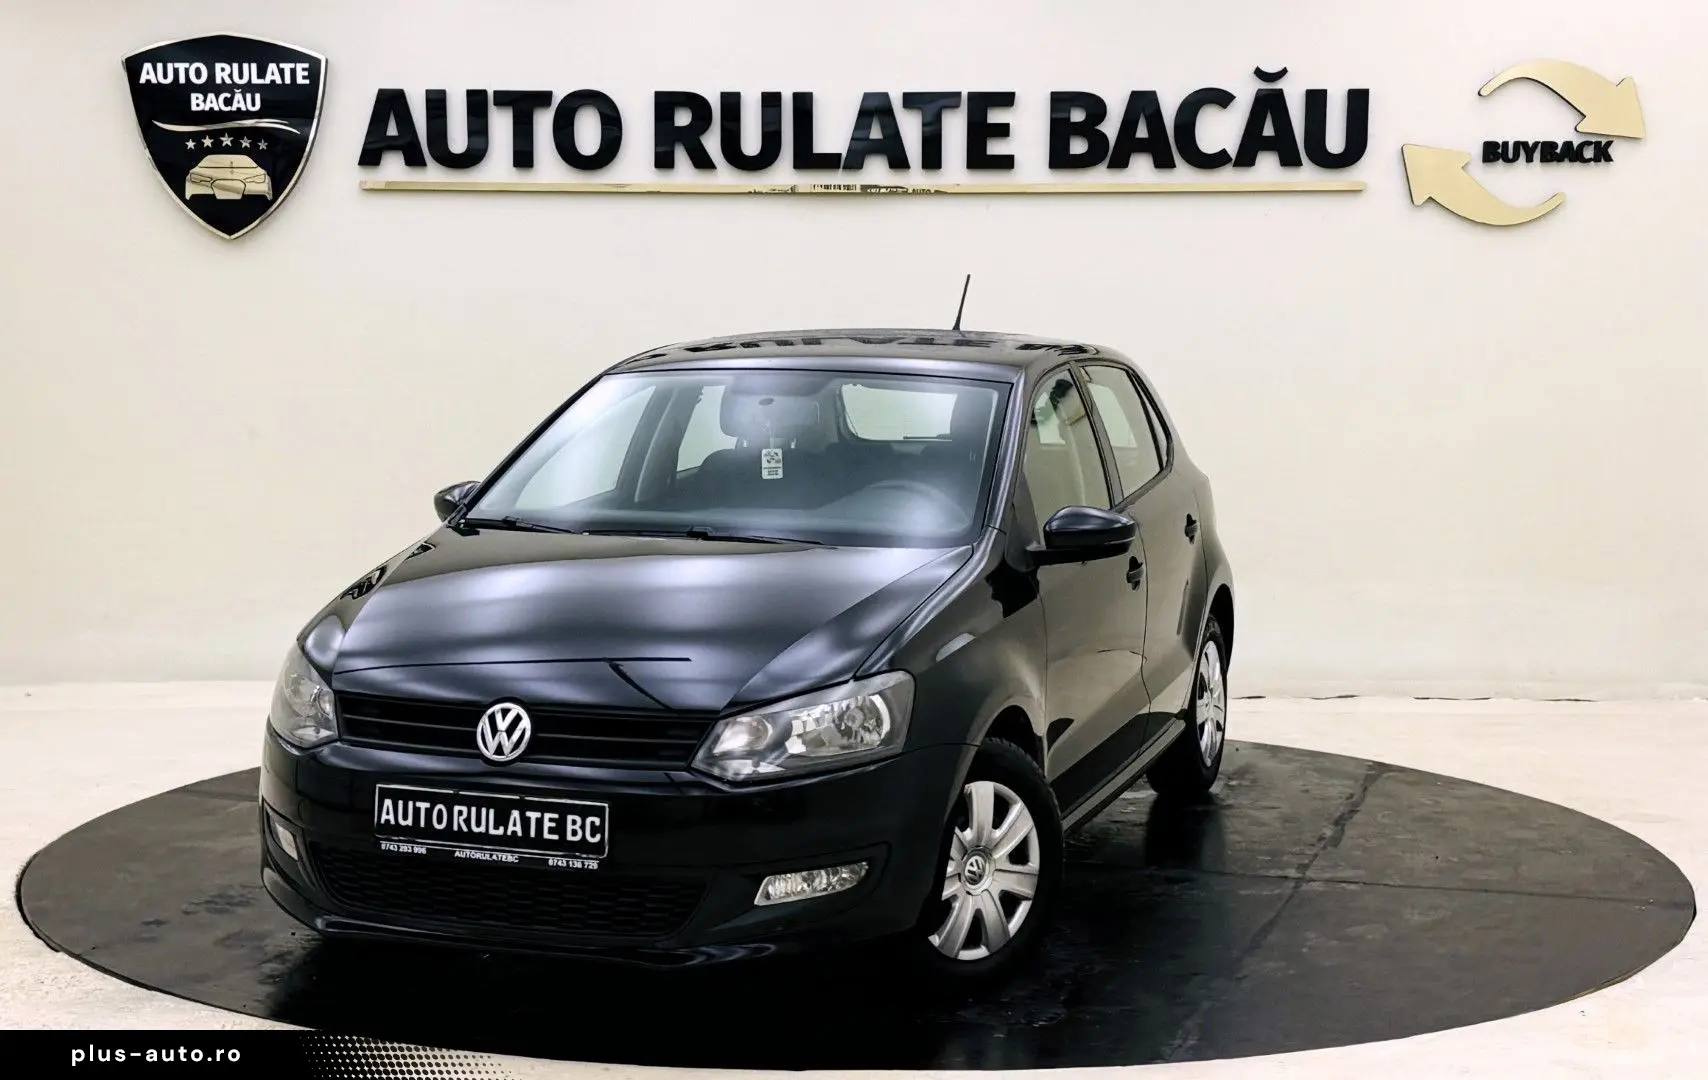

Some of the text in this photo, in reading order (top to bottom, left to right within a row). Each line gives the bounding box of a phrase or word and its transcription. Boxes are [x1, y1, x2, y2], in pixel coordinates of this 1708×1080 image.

[140, 63, 309, 84] AUTO RULATE
[191, 89, 260, 111] BACĂU
[358, 66, 1369, 172] AUTO RULATE BACĂU
[1482, 140, 1613, 163] BUYBACK
[380, 798, 601, 843] AUTO RULATE BC
[454, 850, 519, 863] AUTORULATEBC
